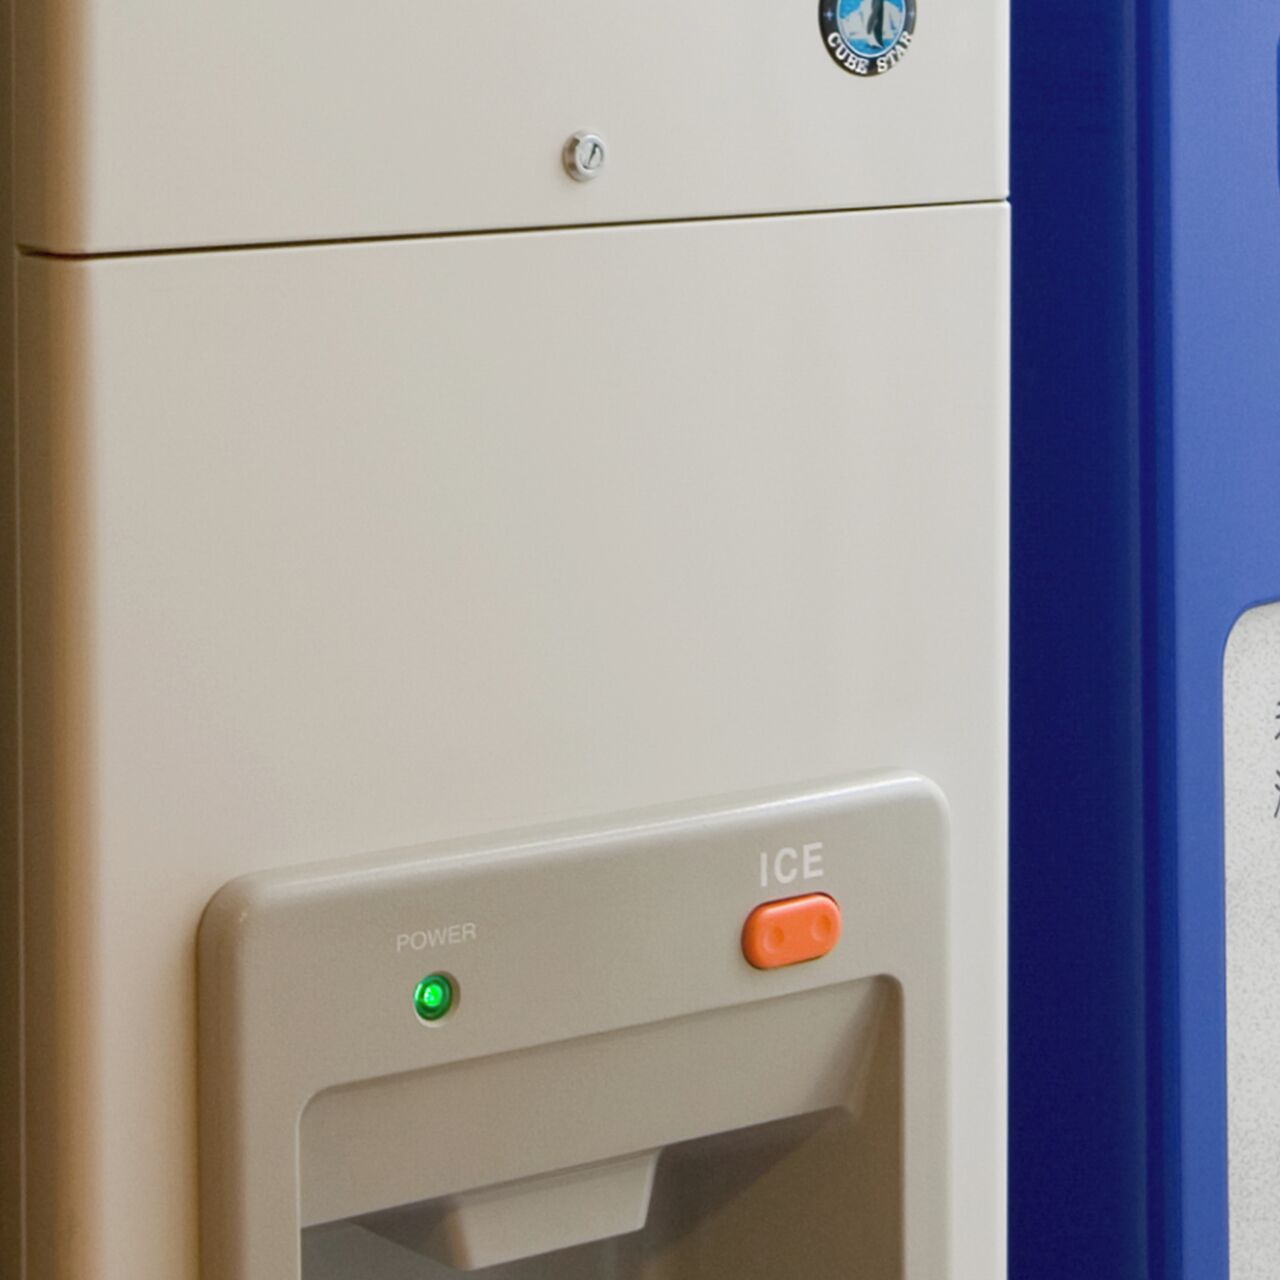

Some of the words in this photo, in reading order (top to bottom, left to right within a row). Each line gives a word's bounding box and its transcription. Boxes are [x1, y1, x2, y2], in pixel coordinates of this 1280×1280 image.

[828, 32, 869, 75] CUBE
[877, 31, 913, 73] STAR
[758, 842, 825, 888] ICE
[397, 921, 478, 954] POWER
